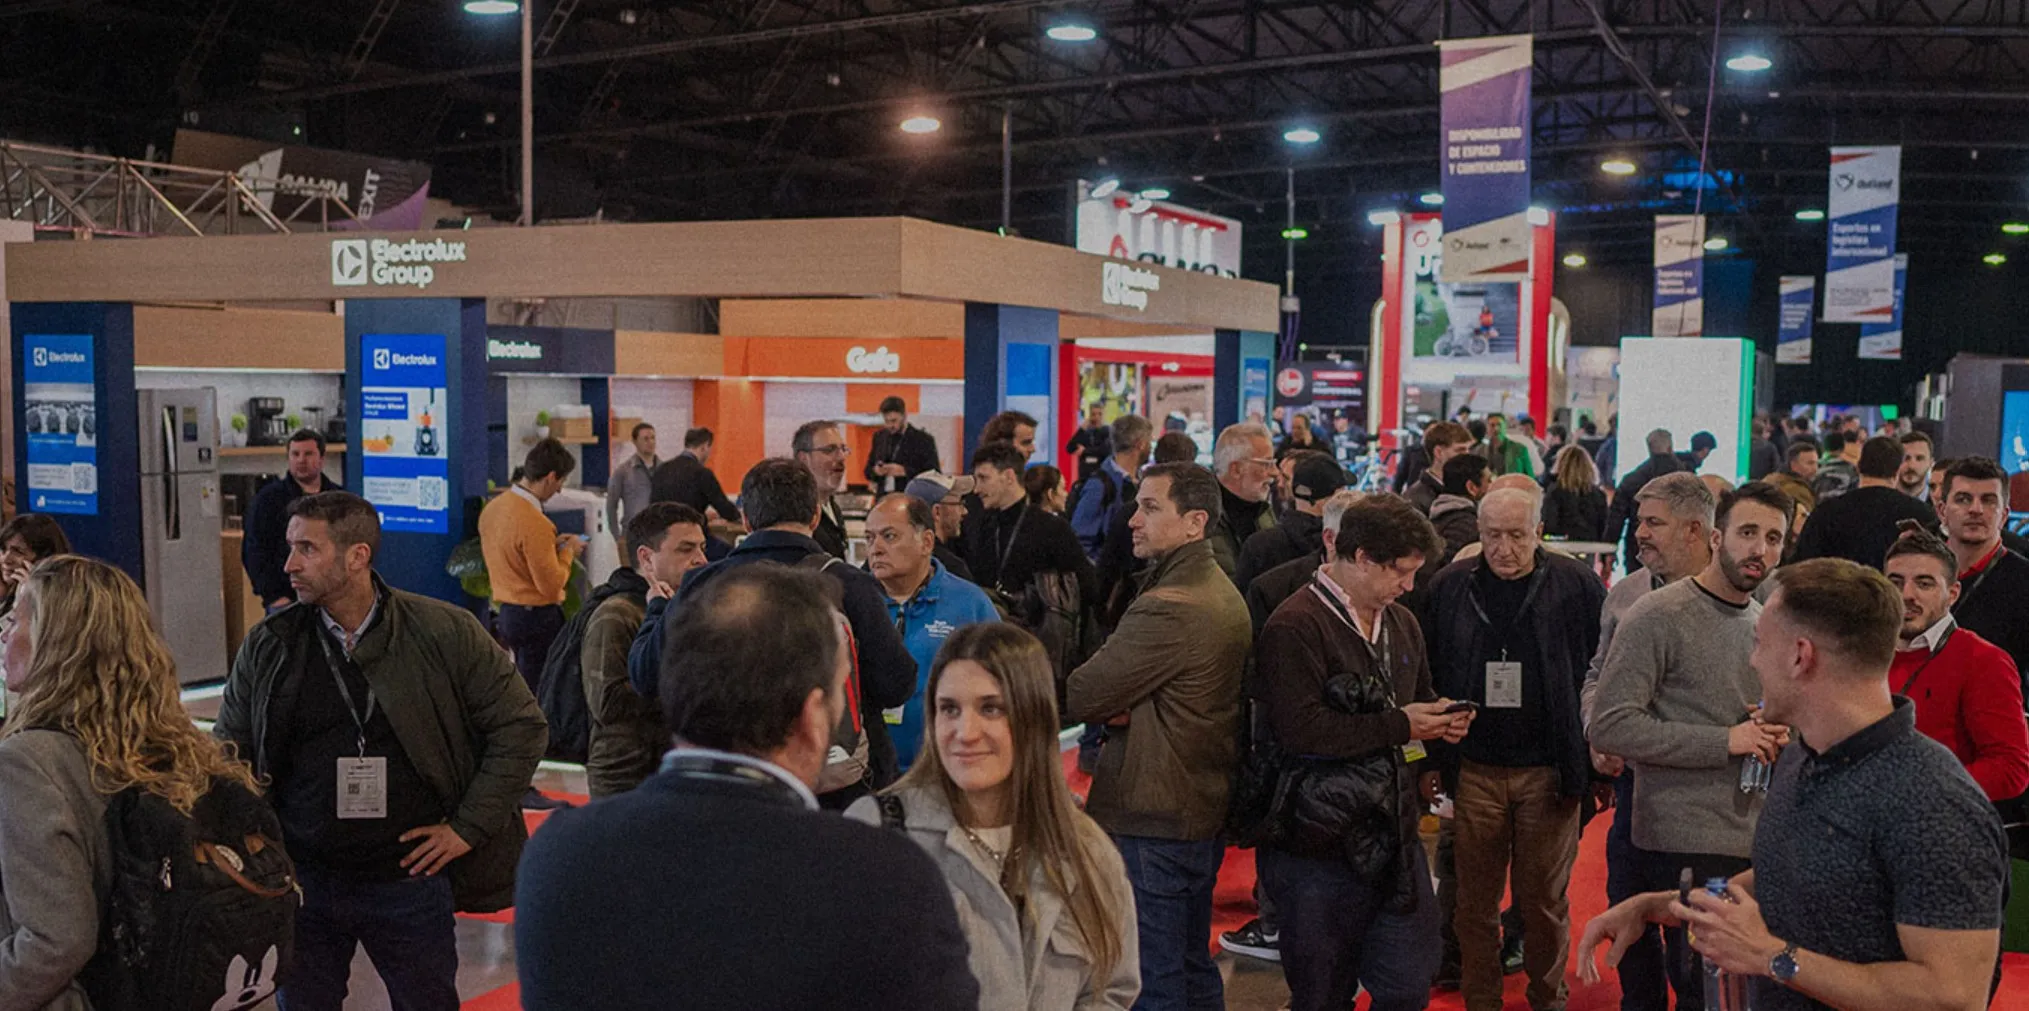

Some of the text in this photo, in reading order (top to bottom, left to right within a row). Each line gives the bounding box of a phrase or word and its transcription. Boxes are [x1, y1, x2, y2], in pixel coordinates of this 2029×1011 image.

[1448, 126, 1522, 143] DISPONIBILIDAD
[1448, 143, 1501, 160] DE ESPACIO
[1448, 159, 1527, 176] Y CONTENEDORES
[357, 167, 382, 222] EXIT
[371, 238, 467, 262] Electrolux
[372, 260, 434, 288] Group
[48, 351, 86, 363] Electrolux
[489, 340, 542, 358] Electrolux
[392, 353, 437, 366] Electrolux
[846, 345, 900, 374] Gafa
